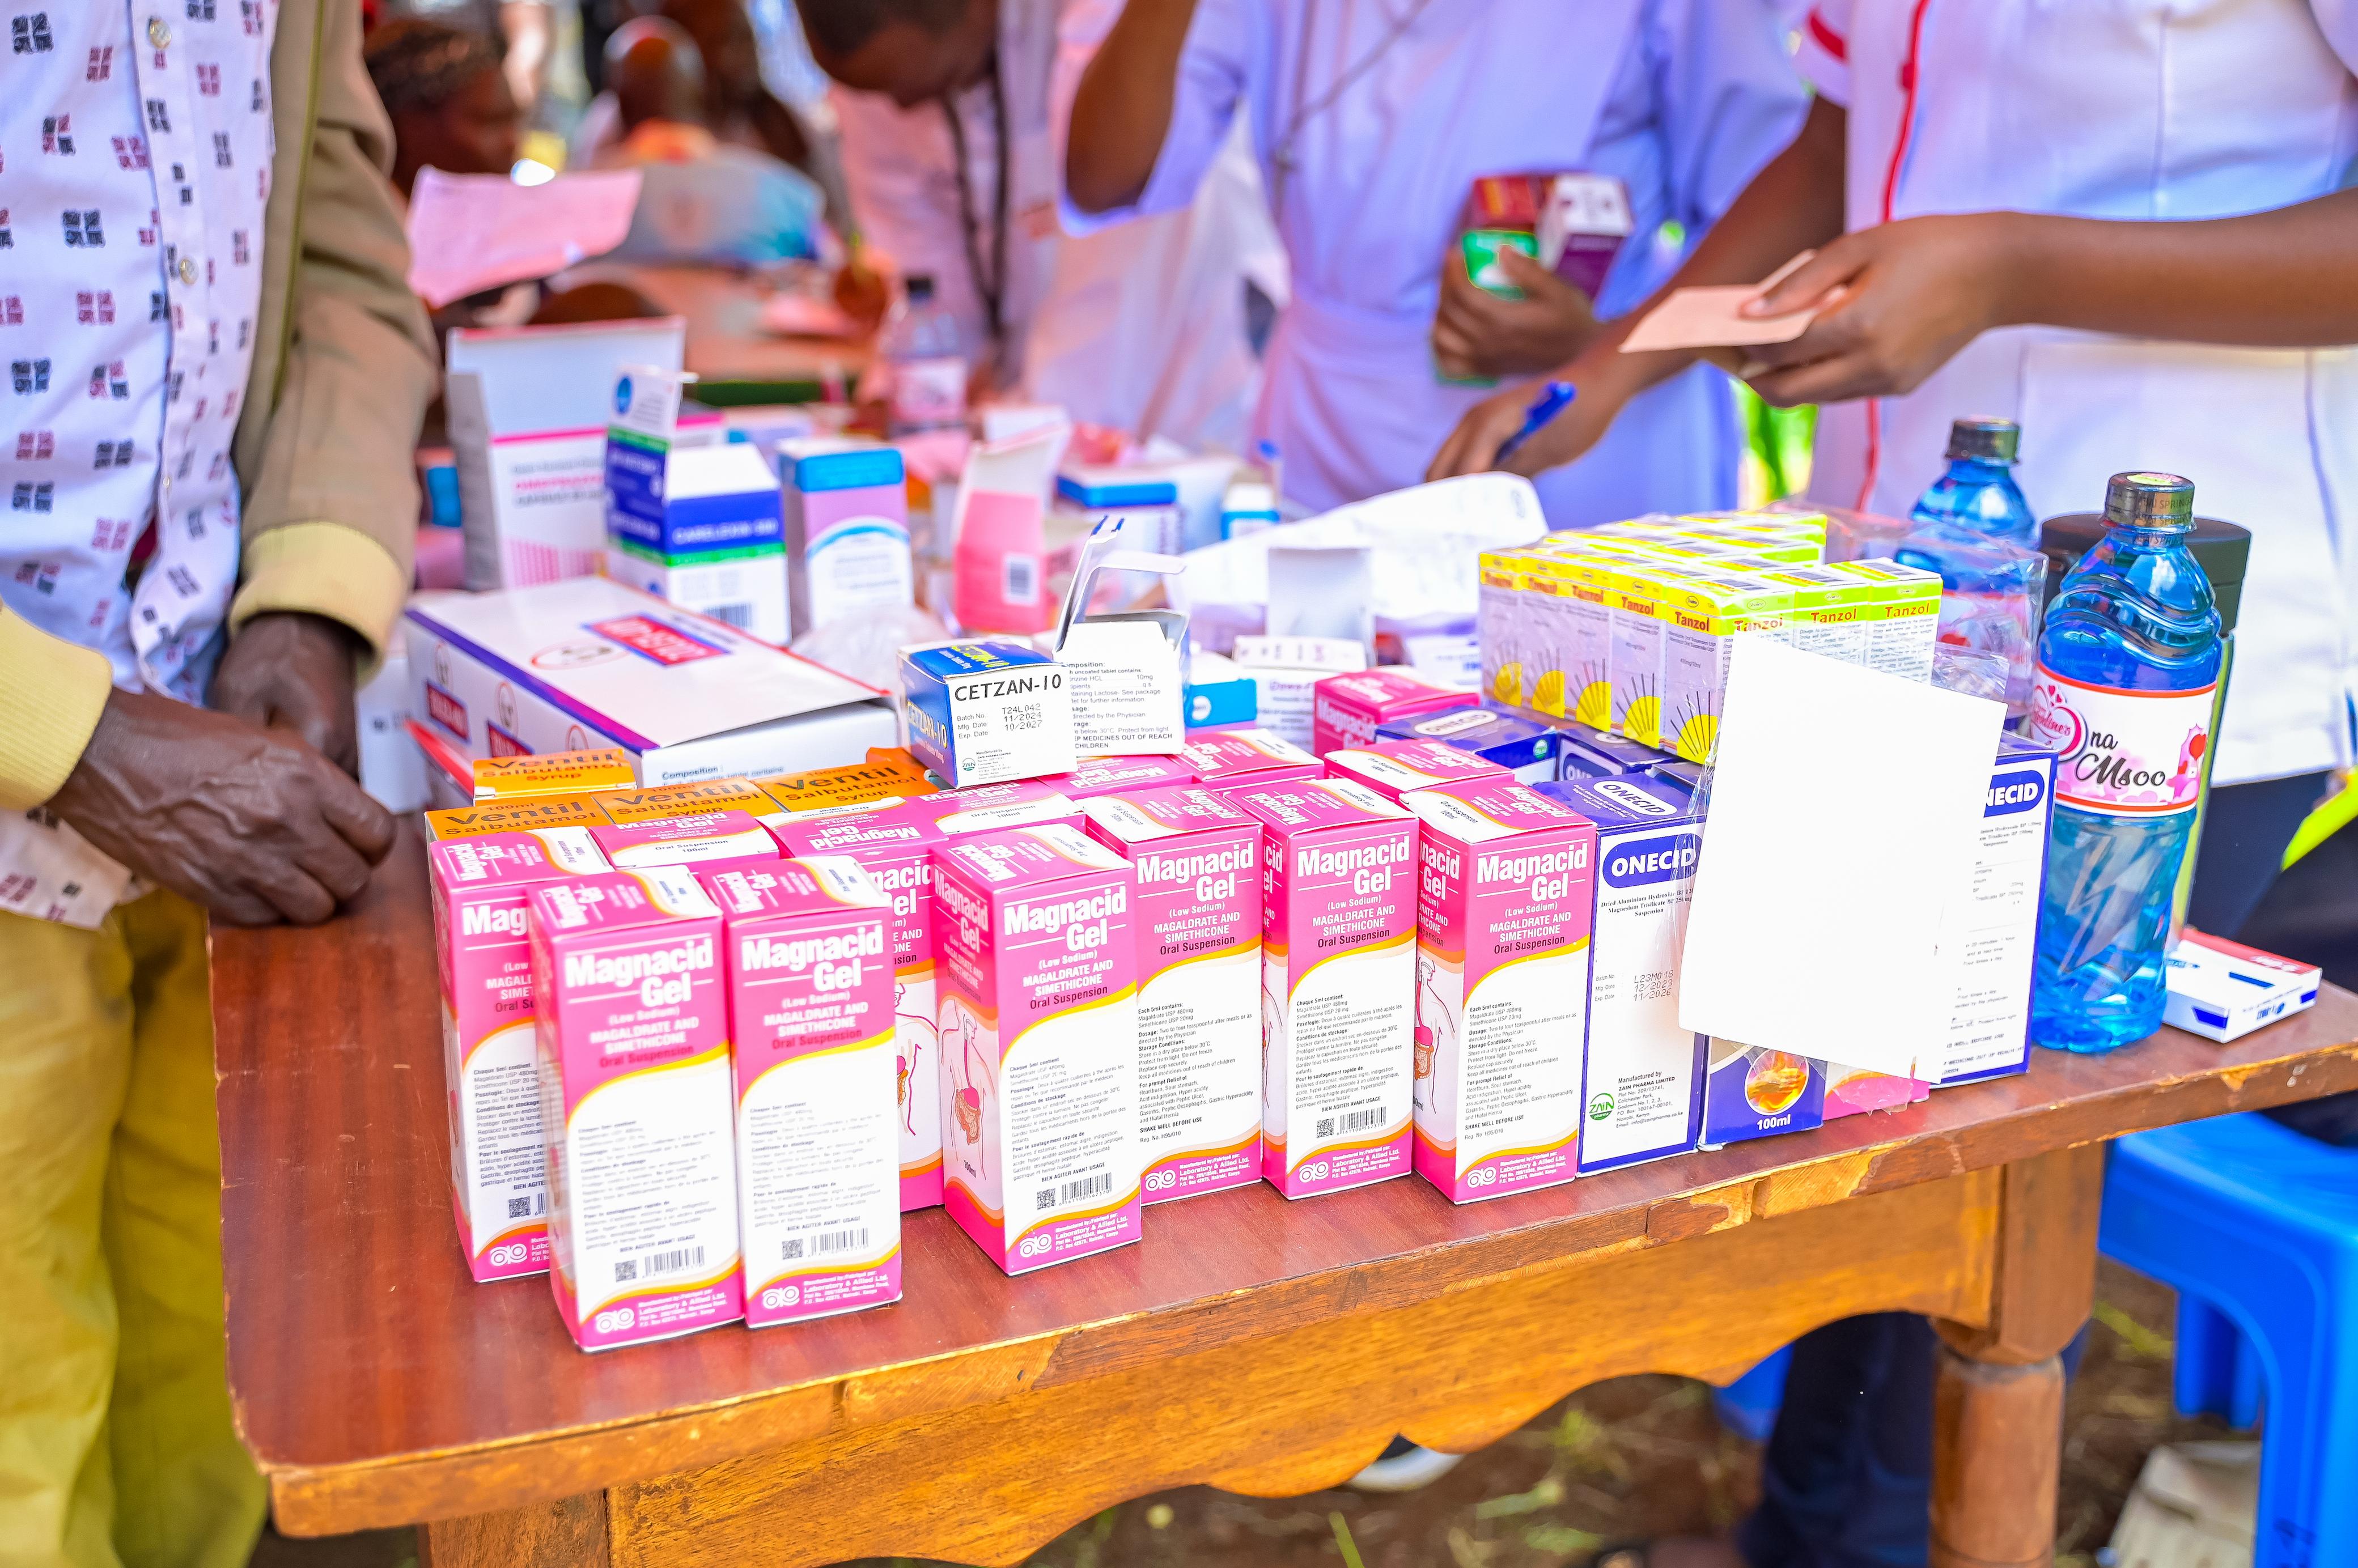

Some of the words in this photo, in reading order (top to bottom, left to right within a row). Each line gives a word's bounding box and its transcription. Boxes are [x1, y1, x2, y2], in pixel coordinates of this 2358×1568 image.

[1622, 597, 1654, 615] Tanzol
[1811, 607, 1856, 624] Tanzol
[1885, 602, 1930, 618] Tanzol
[1675, 611, 1710, 632] Tanzol
[955, 674, 1061, 701] CETZAN-10
[1004, 712, 1041, 722] 11/2024
[1004, 720, 1042, 730] 10/2027
[2090, 732, 2118, 750] na
[482, 762, 623, 777] Salbutamol
[490, 754, 613, 768] Ventil
[2076, 753, 2165, 789] Msoo
[526, 772, 582, 781] Syrup
[775, 767, 901, 791] Ventil
[613, 784, 744, 805] Ventil
[786, 776, 918, 801] Salbutamol
[836, 790, 888, 801] Syrup
[1603, 784, 1665, 813] ONECID
[617, 793, 760, 815] Salbutamol
[667, 806, 723, 817] Syrup
[1502, 786, 1576, 819] Magnacid
[1510, 802, 1545, 815] Gel
[446, 801, 584, 825] Ventil
[614, 813, 728, 830] Magnacid
[446, 812, 597, 835] Salbutamol
[676, 819, 715, 829] Gel
[678, 840, 728, 849] Suspension
[1138, 842, 1254, 885] Magnacid
[1297, 842, 1410, 878] Magnacid
[1477, 843, 1587, 884] Magnacid
[1611, 848, 1697, 877] ONECID
[1195, 872, 1235, 902] Gel
[1353, 866, 1391, 895] Gel
[1423, 866, 1446, 900] Gel
[1530, 873, 1568, 902] Gel
[935, 869, 988, 931] Magnacid
[1169, 906, 1187, 919] (Low
[1189, 901, 1225, 914] Sodium)
[1328, 899, 1347, 912] (Low
[1349, 895, 1381, 907] Sodium)
[1505, 906, 1524, 918] (Low
[1526, 902, 1558, 915] Sodium)
[1609, 904, 1639, 913] Magnesium
[1003, 886, 1127, 936] Magnacid
[1312, 909, 1373, 927] MAGALDRATE
[1377, 905, 1396, 916] AND
[1435, 914, 1448, 927] AND
[1635, 908, 1664, 916] Suspension
[1153, 917, 1219, 934] MAGALDRATE
[1222, 912, 1241, 924] AND
[1323, 918, 1385, 936] SIMETHICONE
[1490, 916, 1549, 933] MAGALDRATE
[1552, 912, 1571, 923] AND
[902, 928, 922, 940] AND
[960, 917, 980, 953] Gel
[1066, 920, 1108, 952] Gel
[1165, 927, 1230, 943] SIMETHICONE
[1317, 936, 1338, 949] Oral
[1340, 928, 1390, 944] Suspension
[1499, 924, 1561, 942] SIMETHICONE
[741, 925, 884, 971] Magnacid
[1160, 942, 1180, 955] Oral
[1182, 936, 1235, 951] Suspension
[1494, 942, 1513, 955] Oral
[1515, 935, 1565, 952] Suspension
[565, 939, 714, 989] Magnacid
[1038, 958, 1061, 970] (Low
[1062, 950, 1097, 965] Sodium)
[813, 958, 862, 992] Gel
[1023, 967, 1089, 987] MAGALDRATE
[1092, 959, 1113, 971] AND
[642, 973, 692, 1008] Gel
[1034, 975, 1102, 997] SIMETHICONE
[1633, 988, 1672, 1001] 11/2026
[1634, 979, 1673, 993] 12/2023
[1030, 997, 1050, 1009] Oral
[1053, 986, 1108, 1005] Suspension
[771, 1038, 795, 1049] Oral
[799, 1029, 862, 1046] Suspension
[599, 1056, 622, 1068] Oral
[628, 1047, 694, 1064] Suspension
[1618, 1072, 1654, 1083] Manufactured
[1618, 1094, 1641, 1103] Colchester
[1140, 1124, 1156, 1133] SHAKE
[1157, 1122, 1172, 1131] WELL
[1172, 1119, 1191, 1127] BEFORE
[1757, 1114, 1791, 1131] 100ml
[1332, 1158, 1364, 1167] Laboratory
